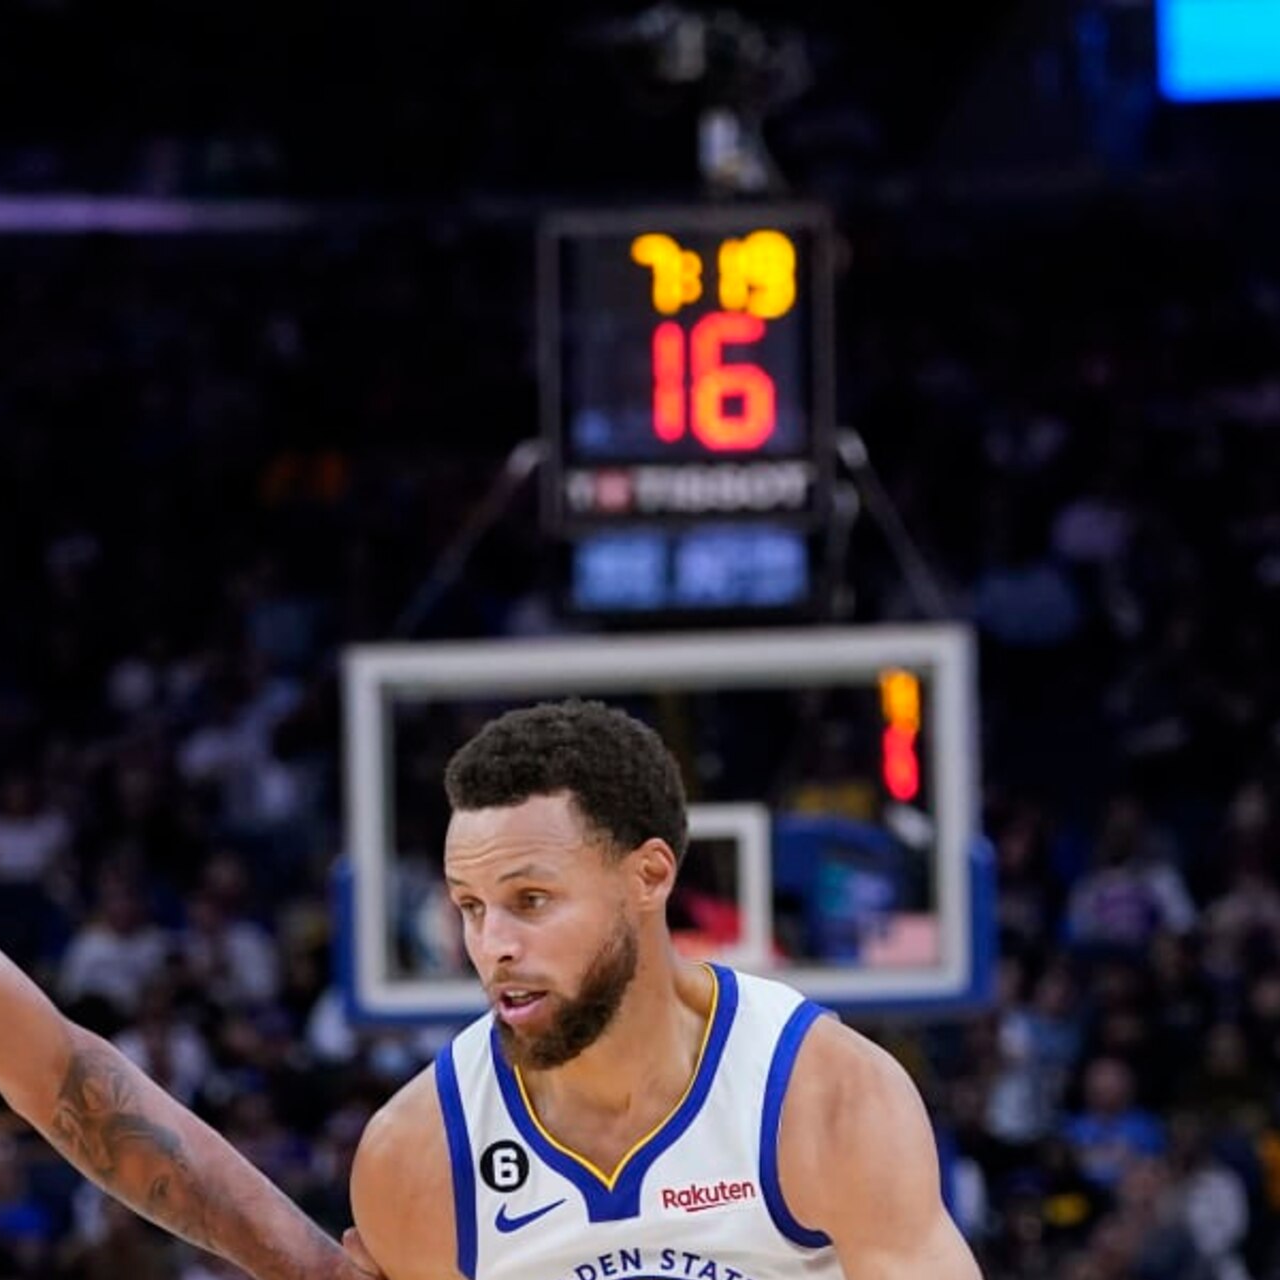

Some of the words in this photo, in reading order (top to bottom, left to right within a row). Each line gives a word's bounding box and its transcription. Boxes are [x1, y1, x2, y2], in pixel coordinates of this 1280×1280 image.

[651, 311, 777, 453] 16
[492, 1147, 520, 1188] 6
[661, 1180, 757, 1212] Rakuten
